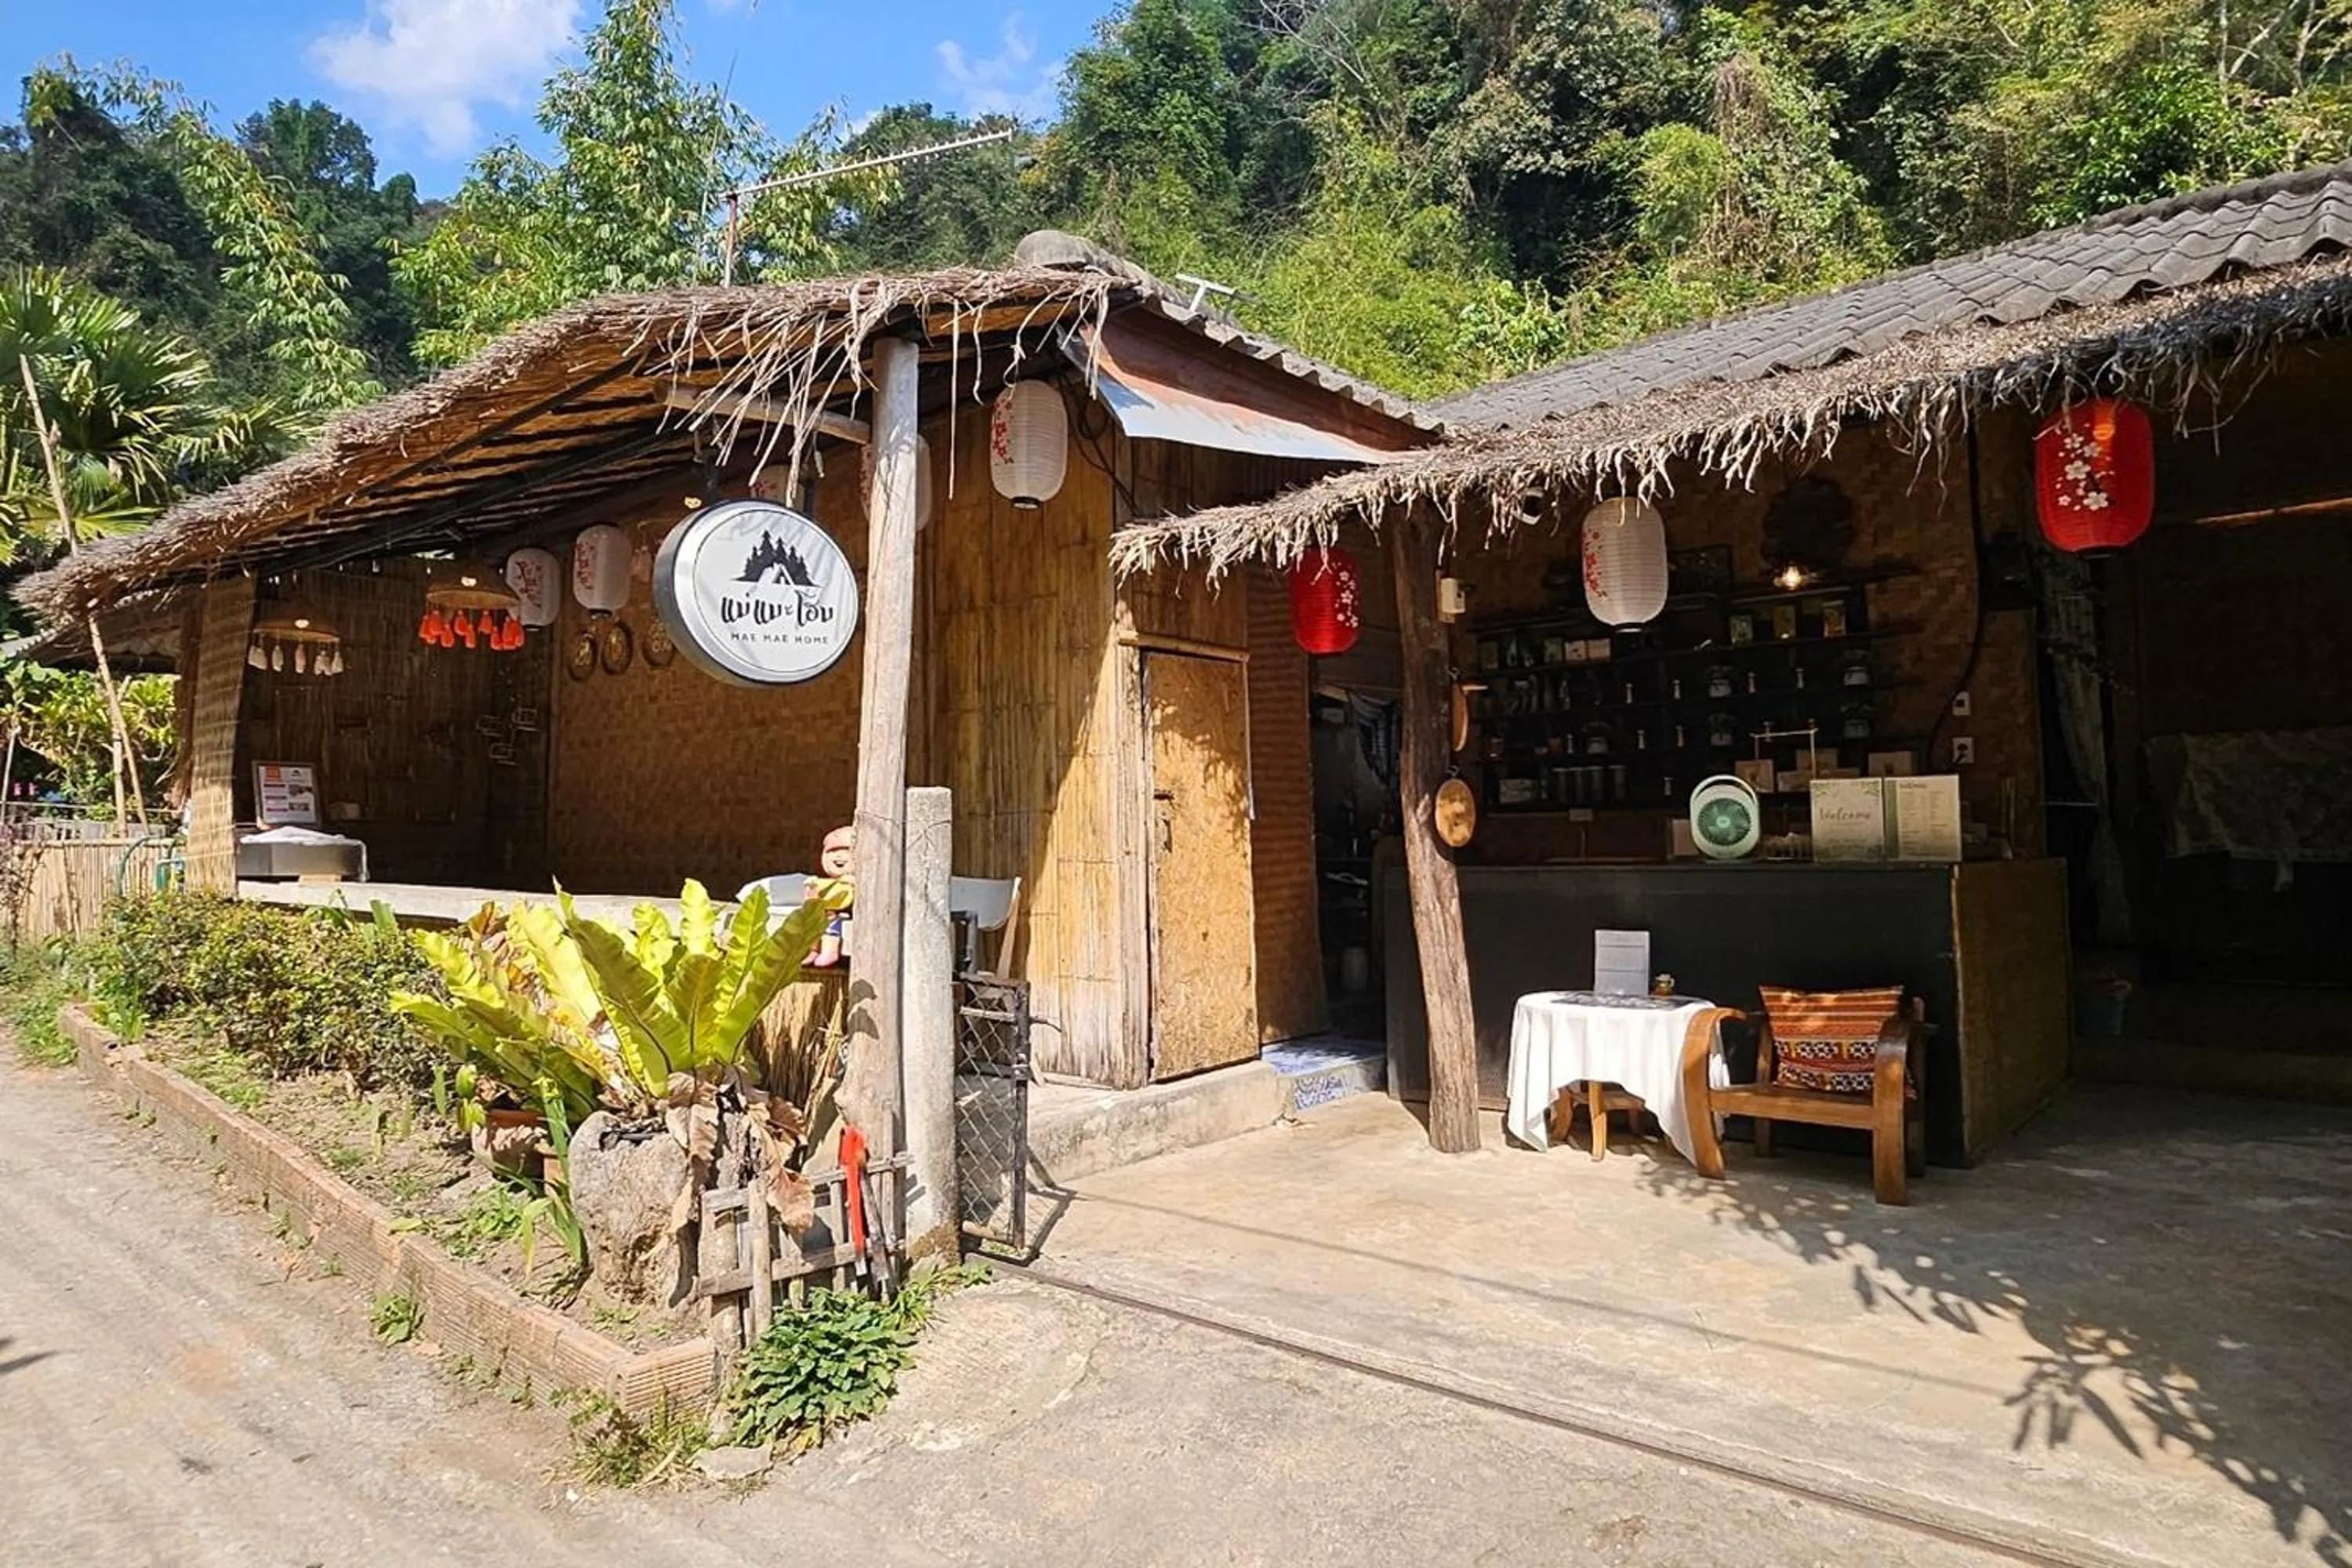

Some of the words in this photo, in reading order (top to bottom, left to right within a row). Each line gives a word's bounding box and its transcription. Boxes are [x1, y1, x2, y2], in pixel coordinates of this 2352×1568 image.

[731, 633, 758, 641] MAE
[764, 633, 789, 643] MAE
[794, 636, 828, 644] HOME
[1820, 807, 1871, 821] Welcome
